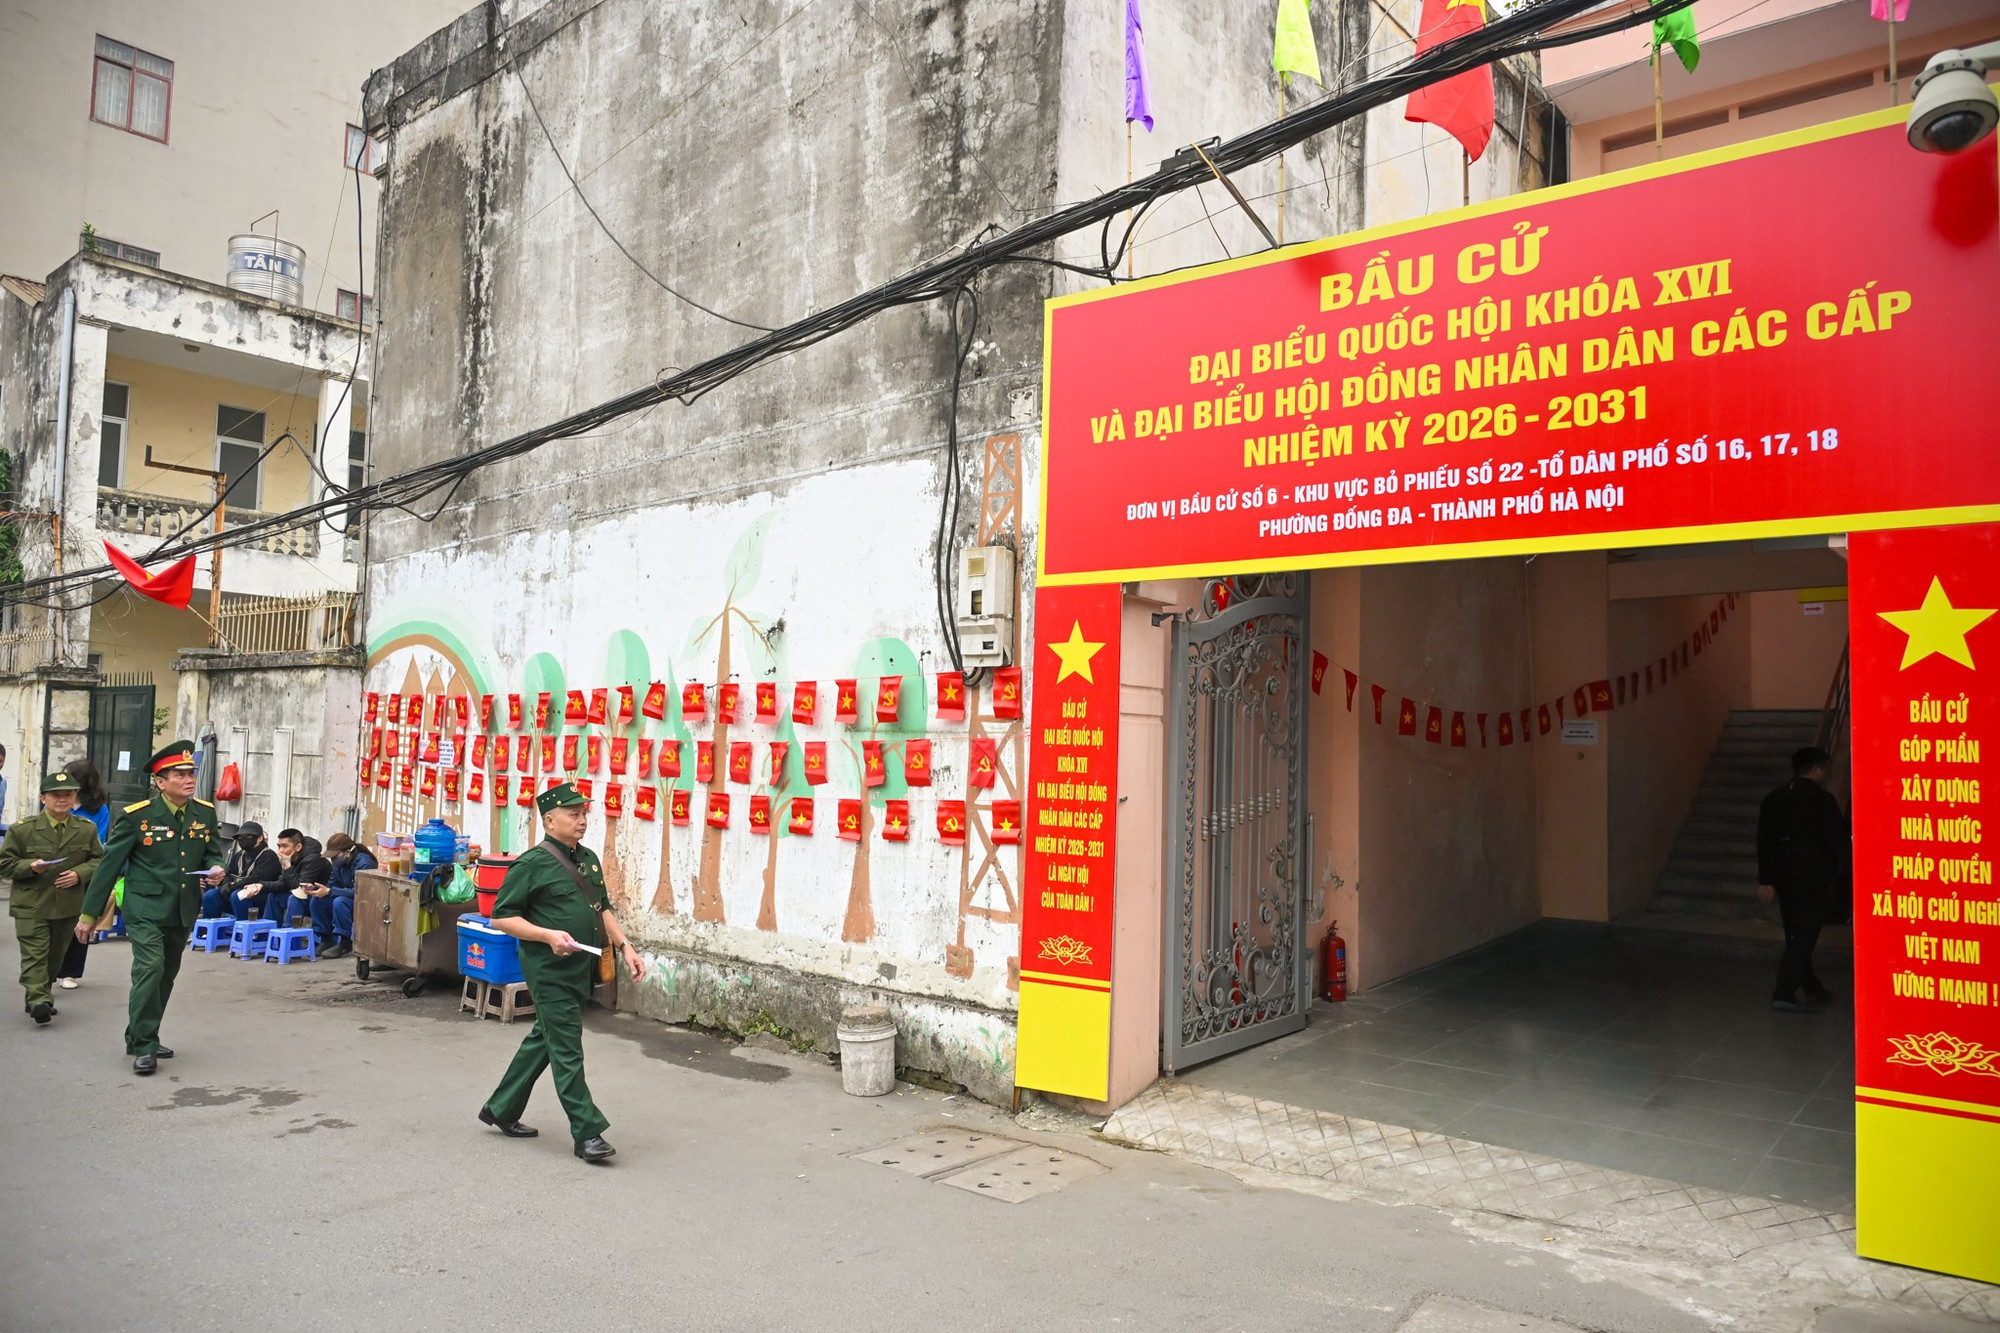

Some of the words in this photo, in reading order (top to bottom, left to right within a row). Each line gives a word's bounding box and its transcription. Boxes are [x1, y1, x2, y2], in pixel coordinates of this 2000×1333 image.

[244, 254, 282, 273] TÂN
[1320, 250, 1434, 312] BẦU
[1457, 221, 1549, 285] CỬ
[1189, 348, 1240, 386] ĐẠI
[1252, 324, 1326, 374] BIỂU
[1338, 306, 1434, 361] QUỐC
[1448, 296, 1511, 342] HỘI
[1526, 275, 1640, 327] KHÓA
[1654, 259, 1732, 306] XVI
[1091, 408, 1126, 444] VÀ
[1134, 404, 1183, 440] ĐẠI
[1194, 383, 1264, 430] BIỂU
[1275, 377, 1329, 420] HỘI
[1341, 362, 1440, 409] ĐỒNG
[1455, 343, 1566, 391] NHÂN
[1583, 326, 1673, 373] DÂN
[1692, 308, 1786, 357] CÁC
[1807, 281, 1911, 339] CẤP
[1244, 424, 1352, 467] NHIỆM
[1366, 411, 1410, 452] KỲ
[1423, 404, 1516, 446] 2026
[1548, 386, 1646, 431] 2031
[1126, 502, 1157, 521] ĐƠN
[1162, 500, 1176, 519] VỊ
[1180, 492, 1210, 515] BẦU
[1216, 488, 1238, 511] CỬ
[1242, 484, 1264, 508] SỐ
[1267, 488, 1278, 505] 6
[1295, 483, 1328, 504] KHU
[1334, 477, 1368, 501] VỰC
[1374, 470, 1398, 495] BỎ
[1404, 464, 1460, 492] PHIẾU
[1466, 459, 1492, 485] SỐ
[1499, 462, 1523, 483] 22
[1571, 450, 1616, 476] DÂN
[1623, 439, 1668, 471] PHỐ
[1676, 435, 1707, 465] SỐ
[1716, 438, 1751, 461] 16,
[1761, 433, 1797, 455] 17,
[1807, 428, 1837, 451] 18
[1259, 513, 1328, 538] PHƯỜNG
[1333, 506, 1382, 531] ĐỐNG
[1388, 506, 1412, 526] ĐA
[1432, 498, 1496, 522] THÀNH
[1503, 488, 1543, 516] PHỐ
[1551, 487, 1579, 513] HÀ
[1586, 484, 1624, 511] NỘI
[1062, 697, 1076, 718] BẦU
[1077, 697, 1087, 718] CỬ
[1910, 692, 1941, 723] BẦU
[1946, 692, 1969, 723] CỬ
[1044, 729, 1055, 748] ĐẠI
[1056, 723, 1071, 745] BIỂU
[1072, 724, 1090, 747] QUỐC
[1092, 727, 1104, 750] HỘI
[1900, 734, 1931, 763] GÓP
[1936, 732, 1980, 763] PHẦN
[1057, 753, 1075, 772] KHÓA
[1076, 757, 1088, 773] XVI
[1037, 779, 1045, 798] VÀ
[1046, 782, 1058, 803] ĐẠI
[1059, 778, 1074, 800] BIỂU
[1076, 781, 1087, 804] HỘI
[1088, 780, 1107, 803] ĐỒNG
[1901, 774, 1931, 802] XÂY
[1936, 778, 1980, 807] DỰNG
[1039, 807, 1057, 826] NHÂN
[1059, 808, 1072, 827] DÂN
[1074, 809, 1088, 829] CÁC
[1089, 807, 1103, 829] CẤP
[1901, 813, 1933, 841] NHÀ
[1938, 815, 1982, 844] NƯỚC
[1035, 834, 1056, 856] NHIỆM
[1058, 835, 1067, 854] KỲ
[1048, 861, 1056, 881] LÀ
[1058, 863, 1076, 883] NGÀY
[1077, 864, 1089, 887] HỘI
[1893, 852, 1934, 881] PHÁP
[1939, 853, 1992, 885] QUYỀN
[1041, 887, 1054, 908] CỦA
[1056, 890, 1074, 911] TOÀN
[1075, 892, 1090, 912] DÂN
[1872, 893, 1893, 917] XÃ
[1898, 891, 1922, 924] HỘI
[1928, 892, 1959, 923] CHỦ
[1905, 932, 1938, 964] VIỆT
[1942, 938, 1980, 964] NAM
[1893, 970, 1934, 1001] VỮNG
[1940, 978, 1988, 1008] MẠNH
